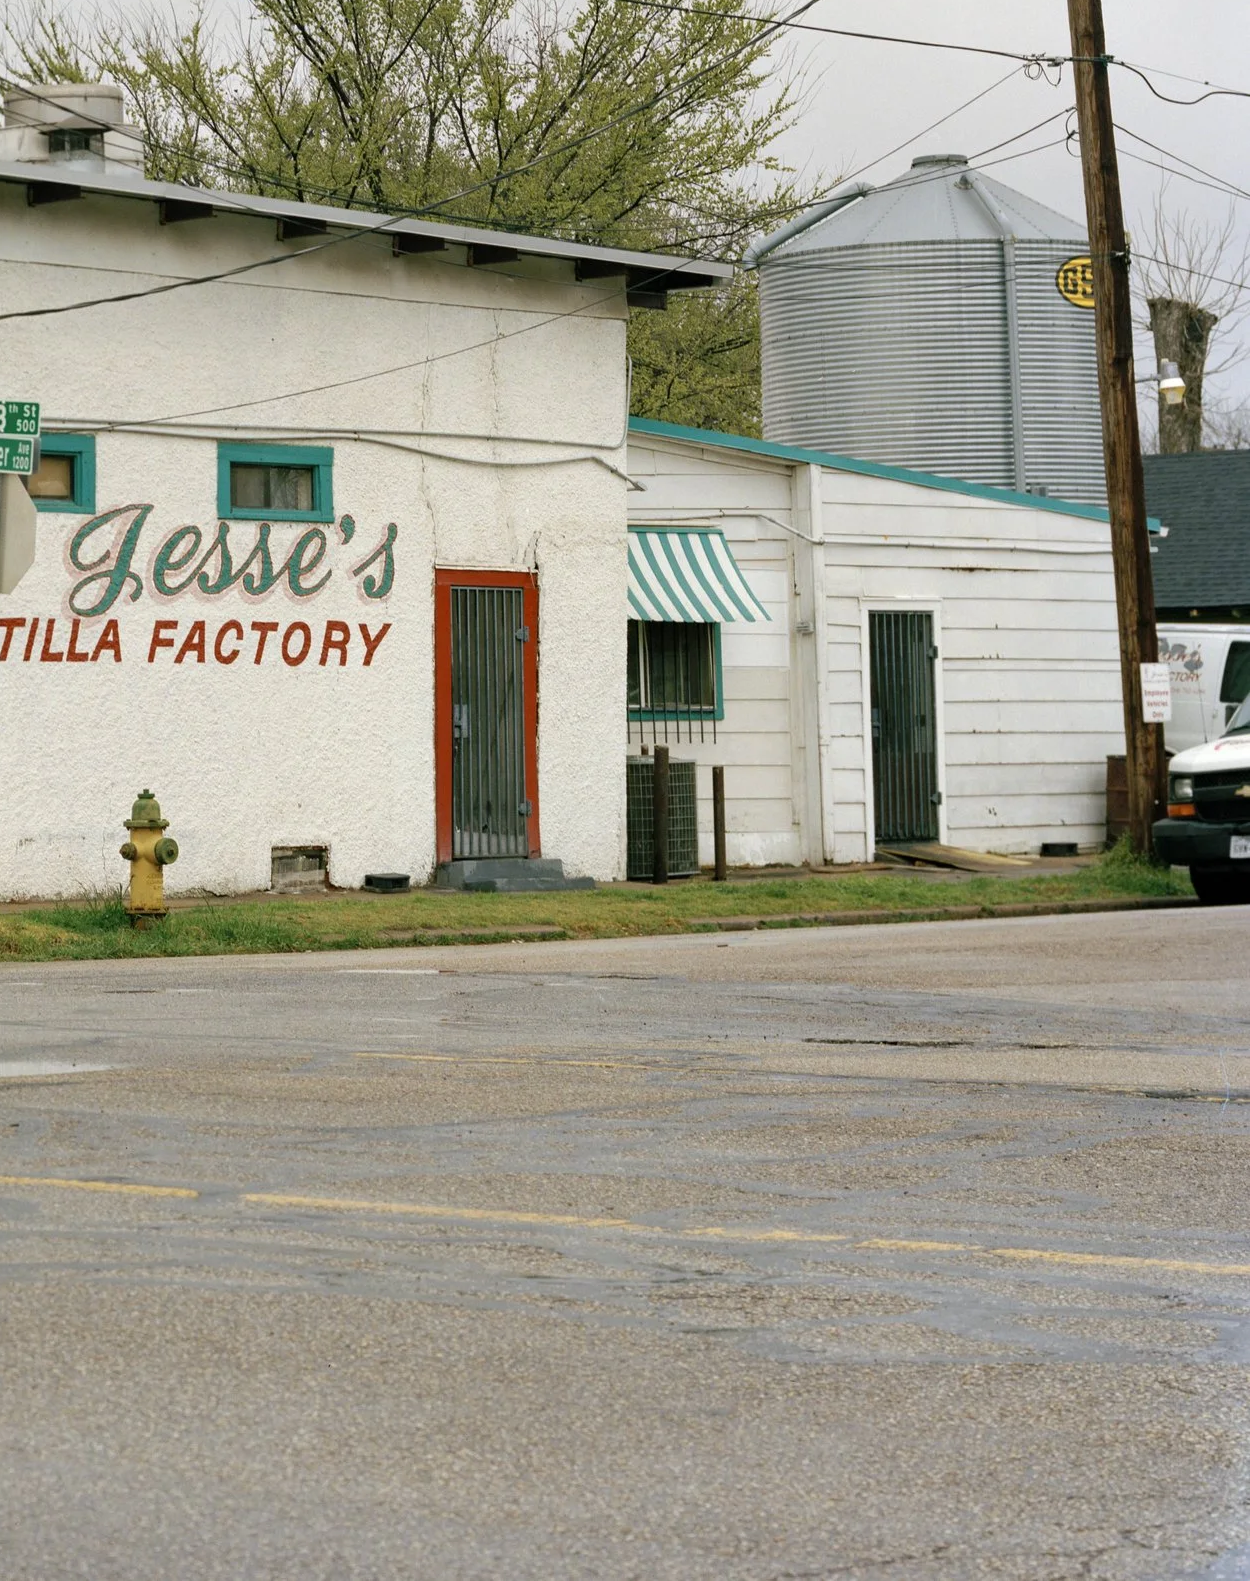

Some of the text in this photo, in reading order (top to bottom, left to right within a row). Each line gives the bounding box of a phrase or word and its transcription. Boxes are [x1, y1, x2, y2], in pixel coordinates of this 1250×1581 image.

[23, 404, 36, 417] St
[16, 419, 36, 432] 500
[18, 442, 30, 455] Ave
[12, 456, 29, 469] 1200
[68, 503, 398, 617] Jesse's
[147, 619, 393, 666] FACTORY
